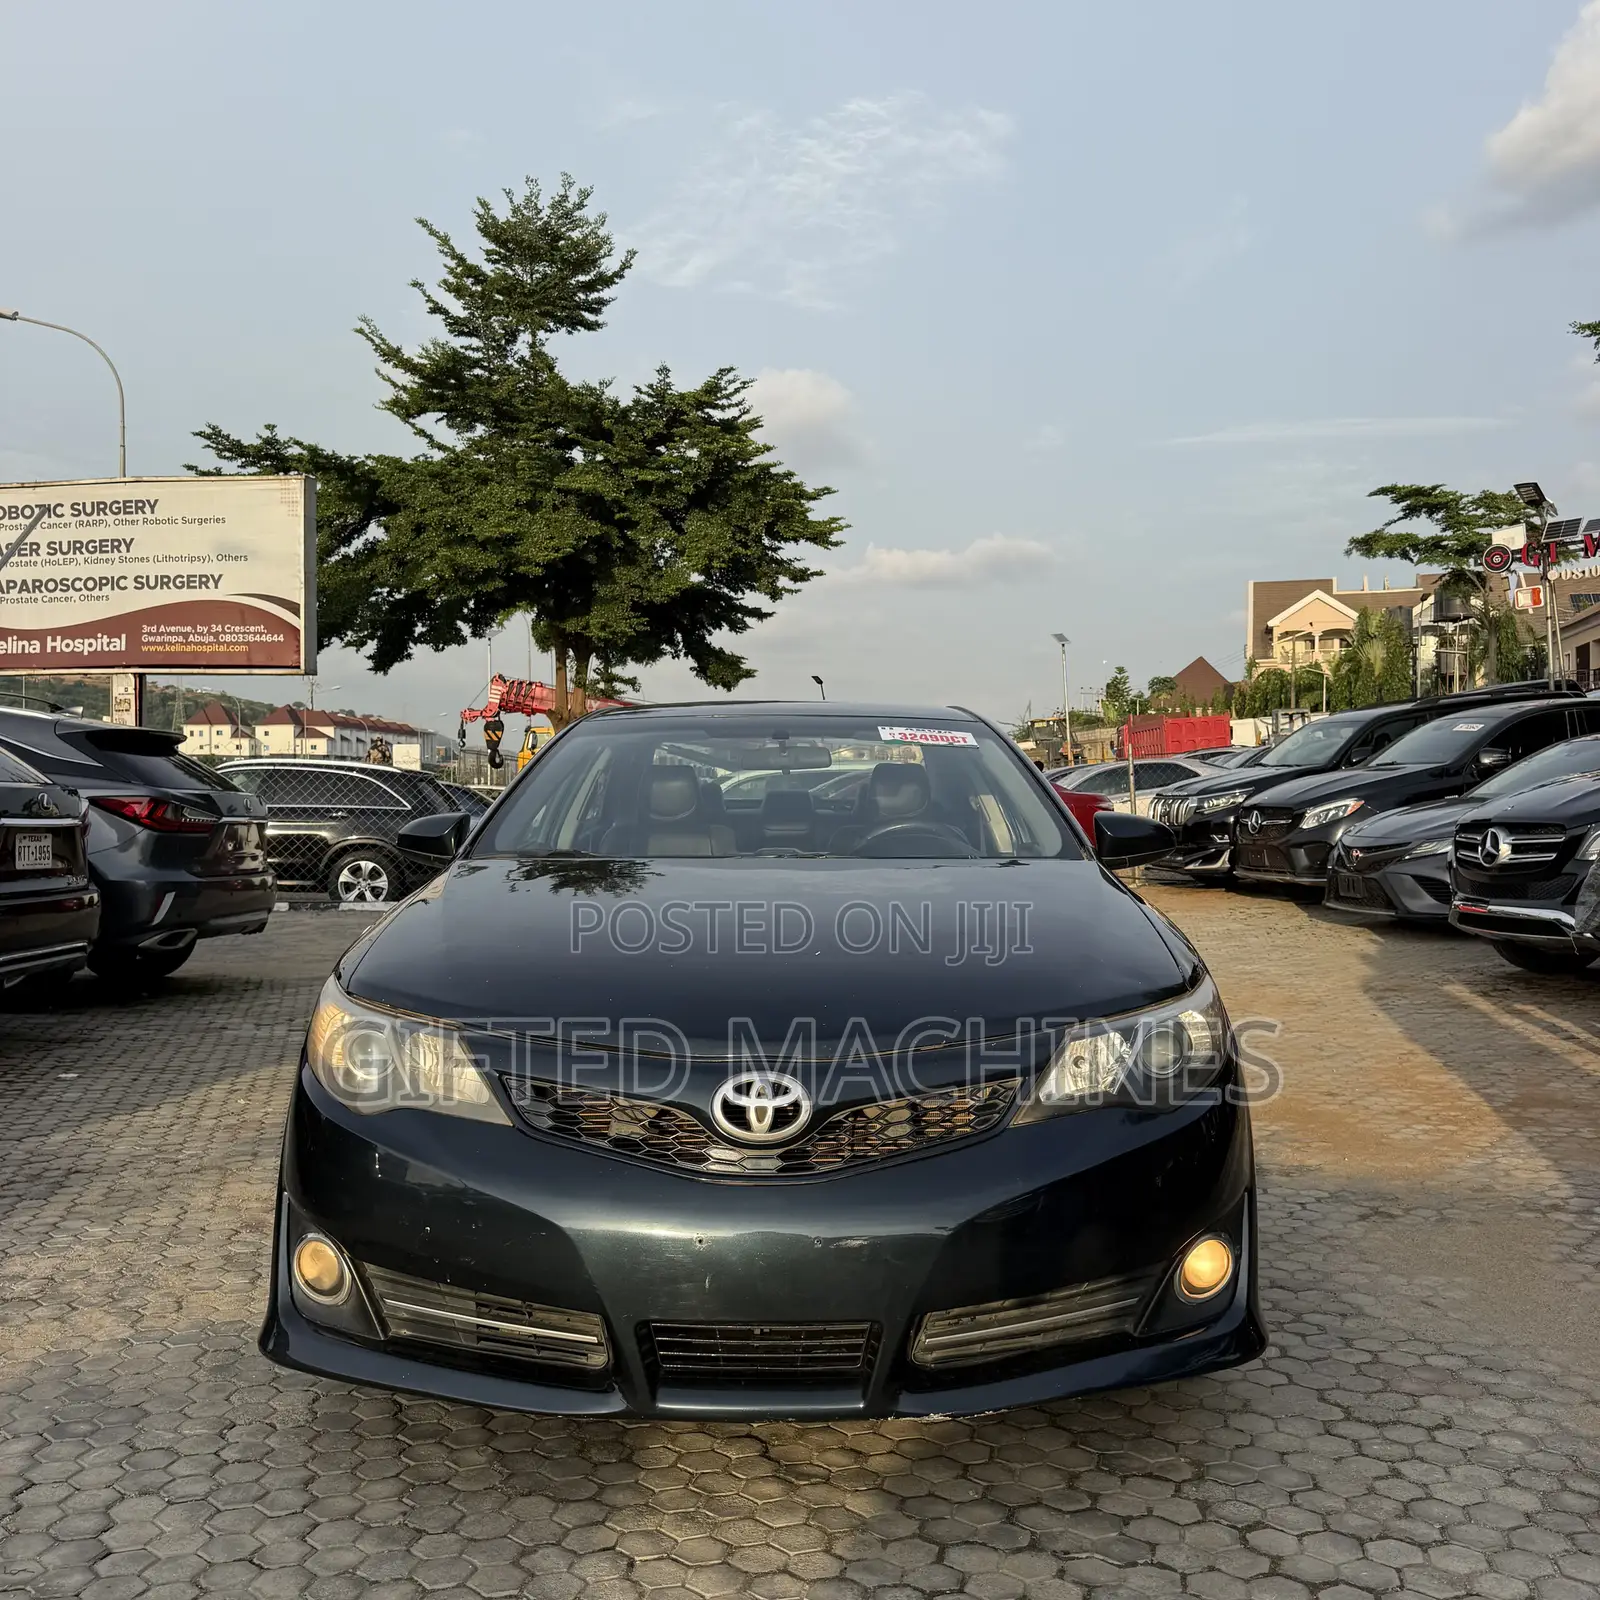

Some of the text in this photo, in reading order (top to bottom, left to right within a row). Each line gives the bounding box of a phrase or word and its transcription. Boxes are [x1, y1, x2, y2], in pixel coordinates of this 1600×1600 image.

[70, 499, 159, 518] SURGERY
[40, 521, 72, 530] Cancer
[75, 519, 111, 530] (RARP),
[113, 517, 140, 527] Other
[142, 516, 179, 526] Robotic
[181, 515, 226, 526] Surgeries
[46, 537, 135, 556] SURGERY
[41, 557, 81, 568] (HoLEP),
[83, 556, 116, 567] Kidney
[118, 555, 150, 564] Stones
[152, 553, 214, 565] (Lithotripsy),
[216, 552, 248, 562] Others
[133, 573, 224, 591] SURGERY
[41, 595, 77, 605] Cancer,
[79, 593, 110, 602] Others
[141, 624, 268, 635] 3rd Avenue, by 34 Crescent,
[46, 633, 126, 656] Hospital
[141, 633, 284, 645] Gwarinpa, Abuja. 08033644644
[141, 643, 249, 654] www.kelinahospital.com
